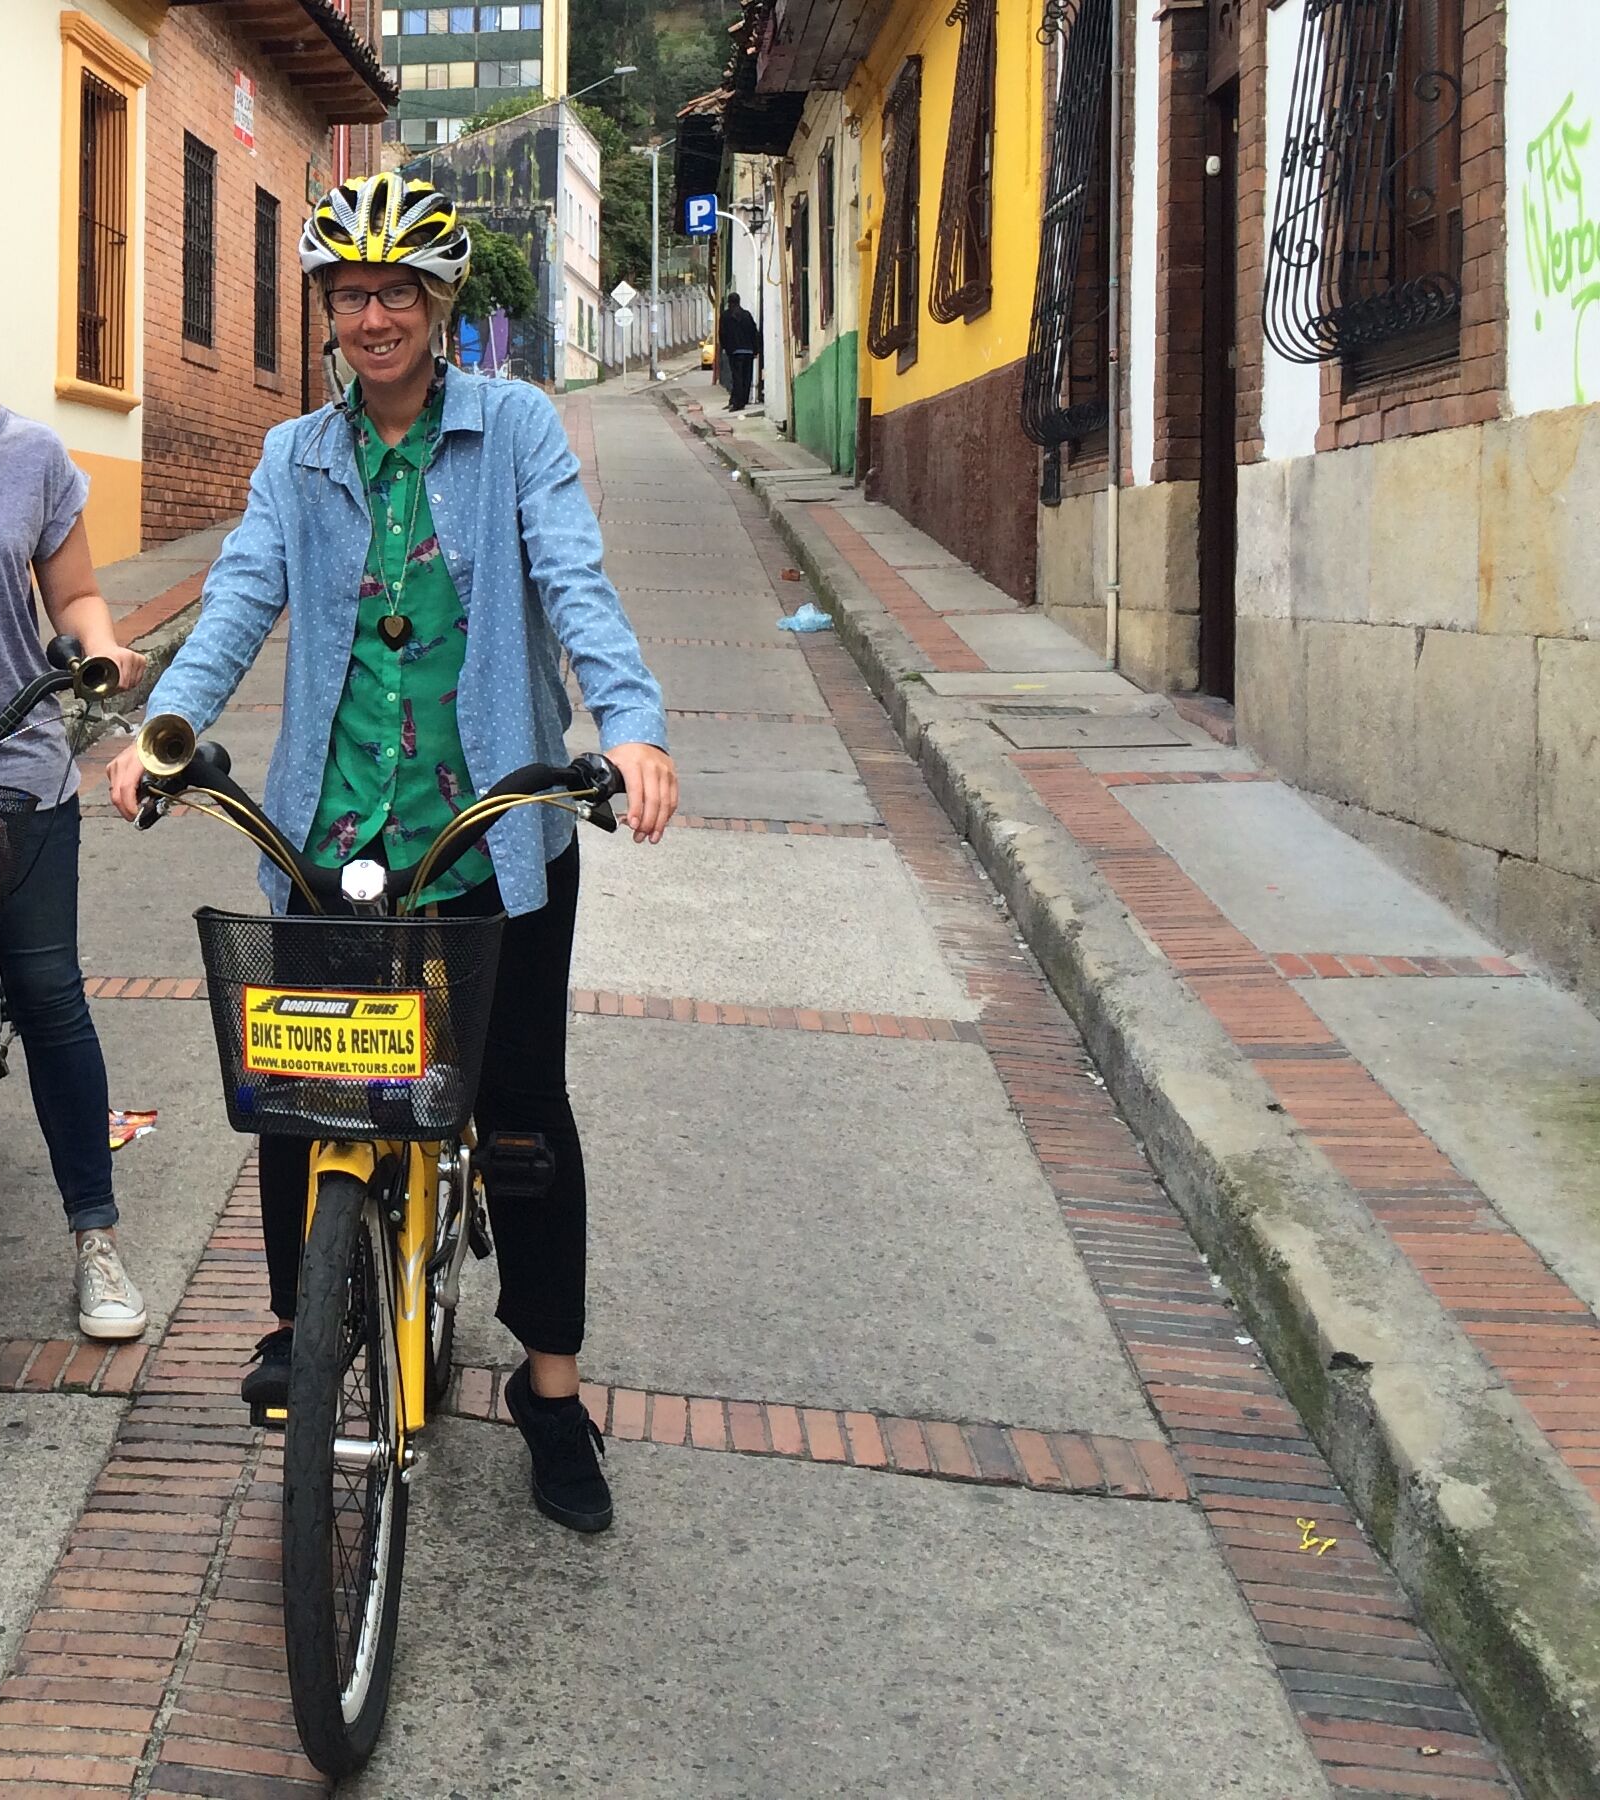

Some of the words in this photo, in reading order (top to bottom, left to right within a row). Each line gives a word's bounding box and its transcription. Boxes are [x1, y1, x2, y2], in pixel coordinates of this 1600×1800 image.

[689, 199, 711, 226] P
[280, 999, 349, 1014] BOGOTRAVEL
[361, 1003, 399, 1015] TOURS
[251, 1021, 282, 1050] BIKE
[286, 1024, 332, 1053] TOURS
[336, 1027, 347, 1053] &
[351, 1028, 414, 1055] RENTALS
[251, 1055, 416, 1074] WWW.BOGOTRAVELTOURS.COM
